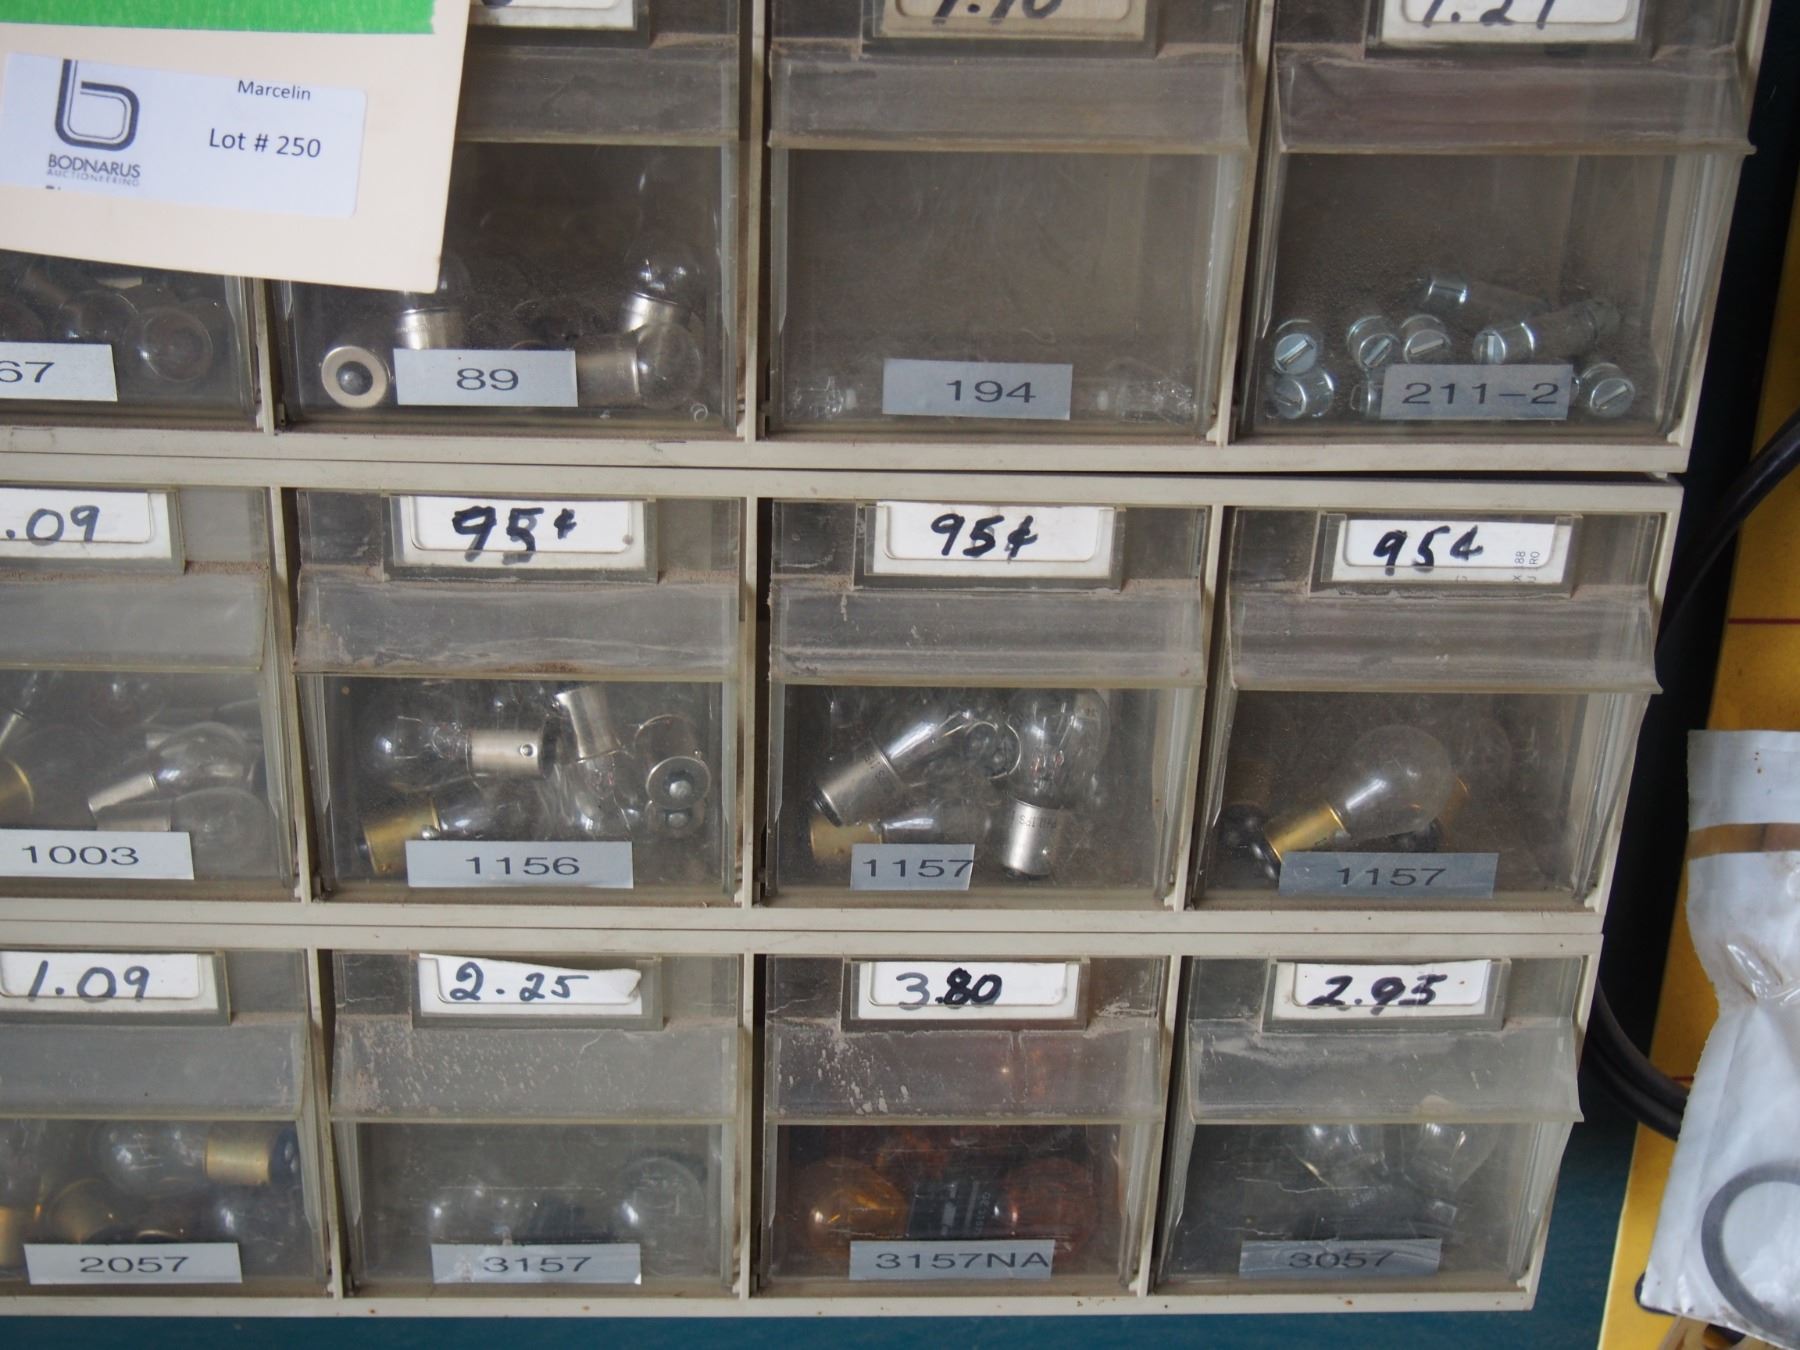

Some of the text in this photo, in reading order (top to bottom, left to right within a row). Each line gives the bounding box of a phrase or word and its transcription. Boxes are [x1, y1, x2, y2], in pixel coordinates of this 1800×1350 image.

[237, 79, 311, 101] Marcelin
[208, 127, 322, 158] Lot # 250
[47, 167, 140, 187] AUCTIONEERING
[48, 153, 141, 179] BODNARUS
[455, 367, 519, 391] 89
[946, 378, 1037, 404] 194
[1401, 382, 1560, 406] 211-2
[20, 845, 140, 866] 1003
[465, 856, 581, 876] 1156
[862, 858, 974, 879] 1157
[1336, 866, 1447, 887] 1157
[28, 959, 151, 1004] 1.09
[449, 961, 590, 1002] 2.25
[895, 967, 1003, 1011] 3.80
[1306, 974, 1449, 1016] 2.95
[79, 1255, 190, 1275] 2057
[482, 1255, 593, 1274] 3157
[875, 1251, 1050, 1271] 3157NA
[1288, 1250, 1395, 1271] 3057
